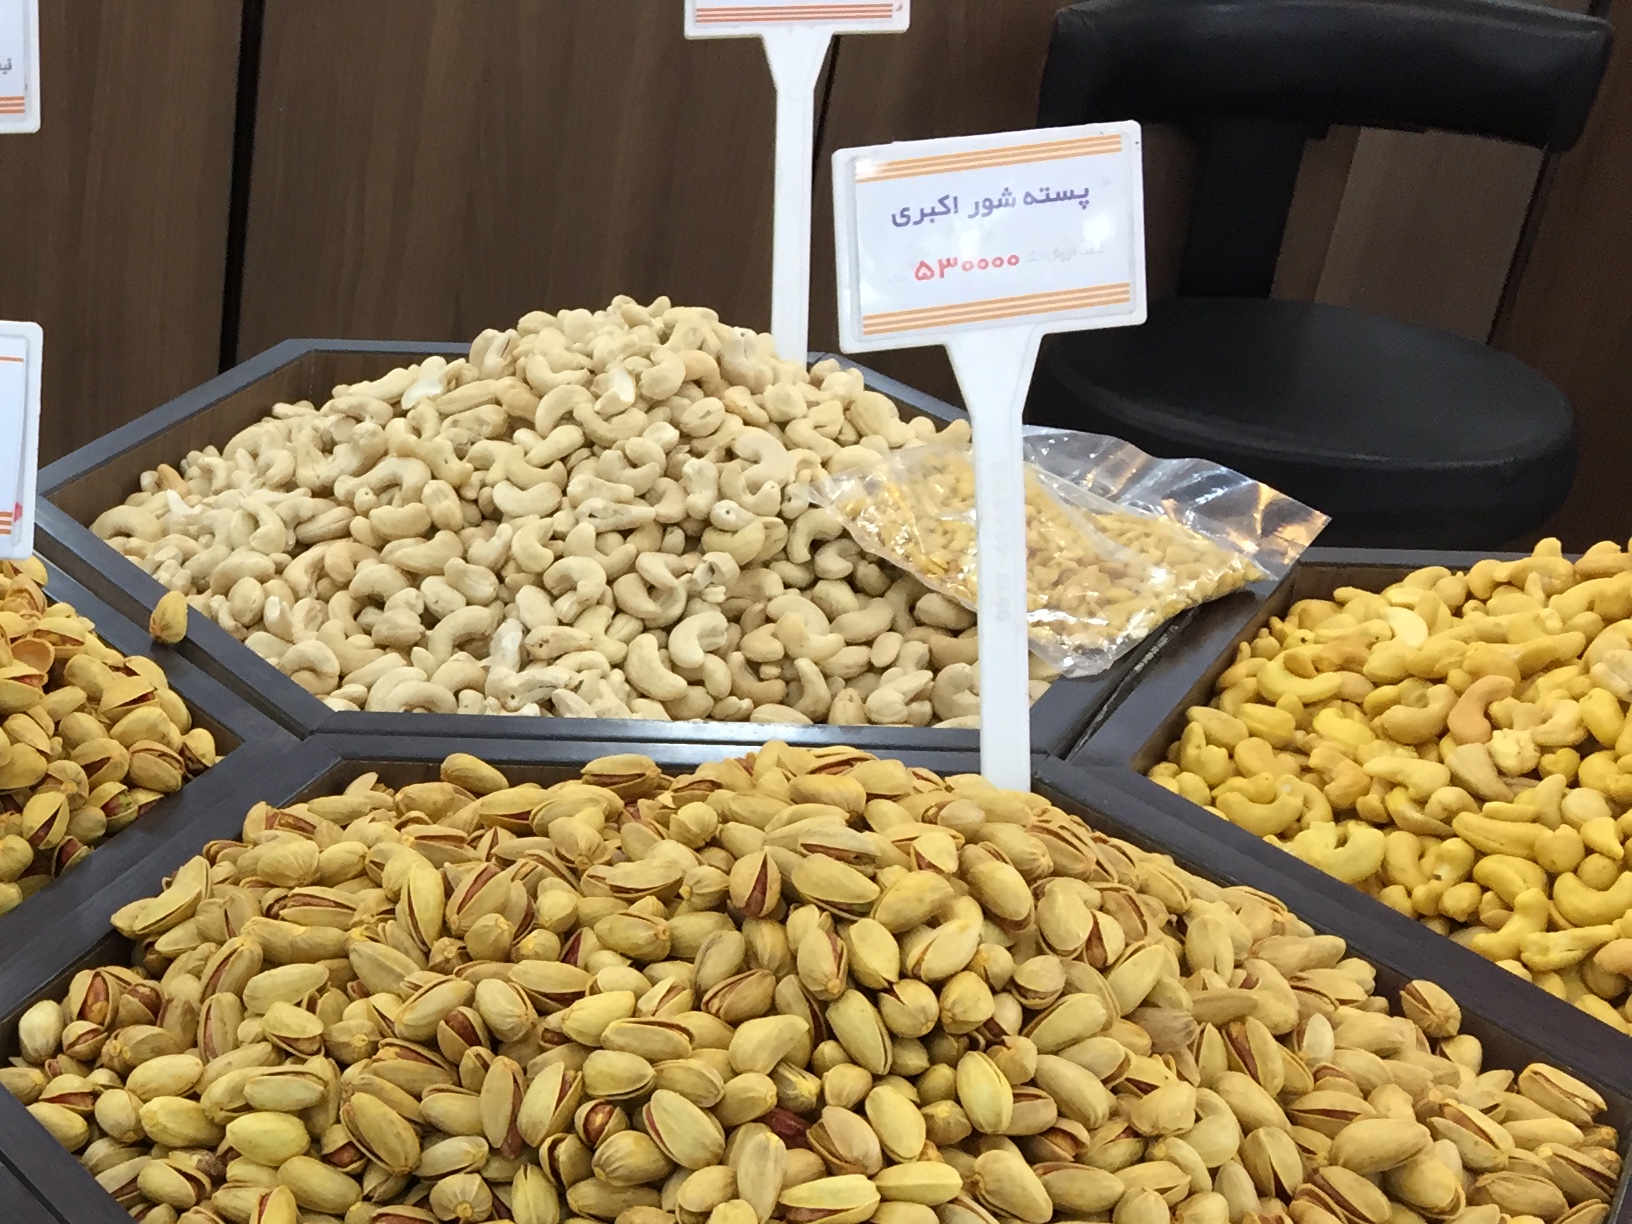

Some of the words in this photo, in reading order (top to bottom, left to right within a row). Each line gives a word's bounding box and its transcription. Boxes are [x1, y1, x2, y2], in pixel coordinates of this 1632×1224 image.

[892, 194, 958, 227] اکبری
[968, 187, 1016, 218] شور
[1023, 187, 1089, 209] پسته
[915, 255, 1019, 281] ۵۳۰۰۰۰
